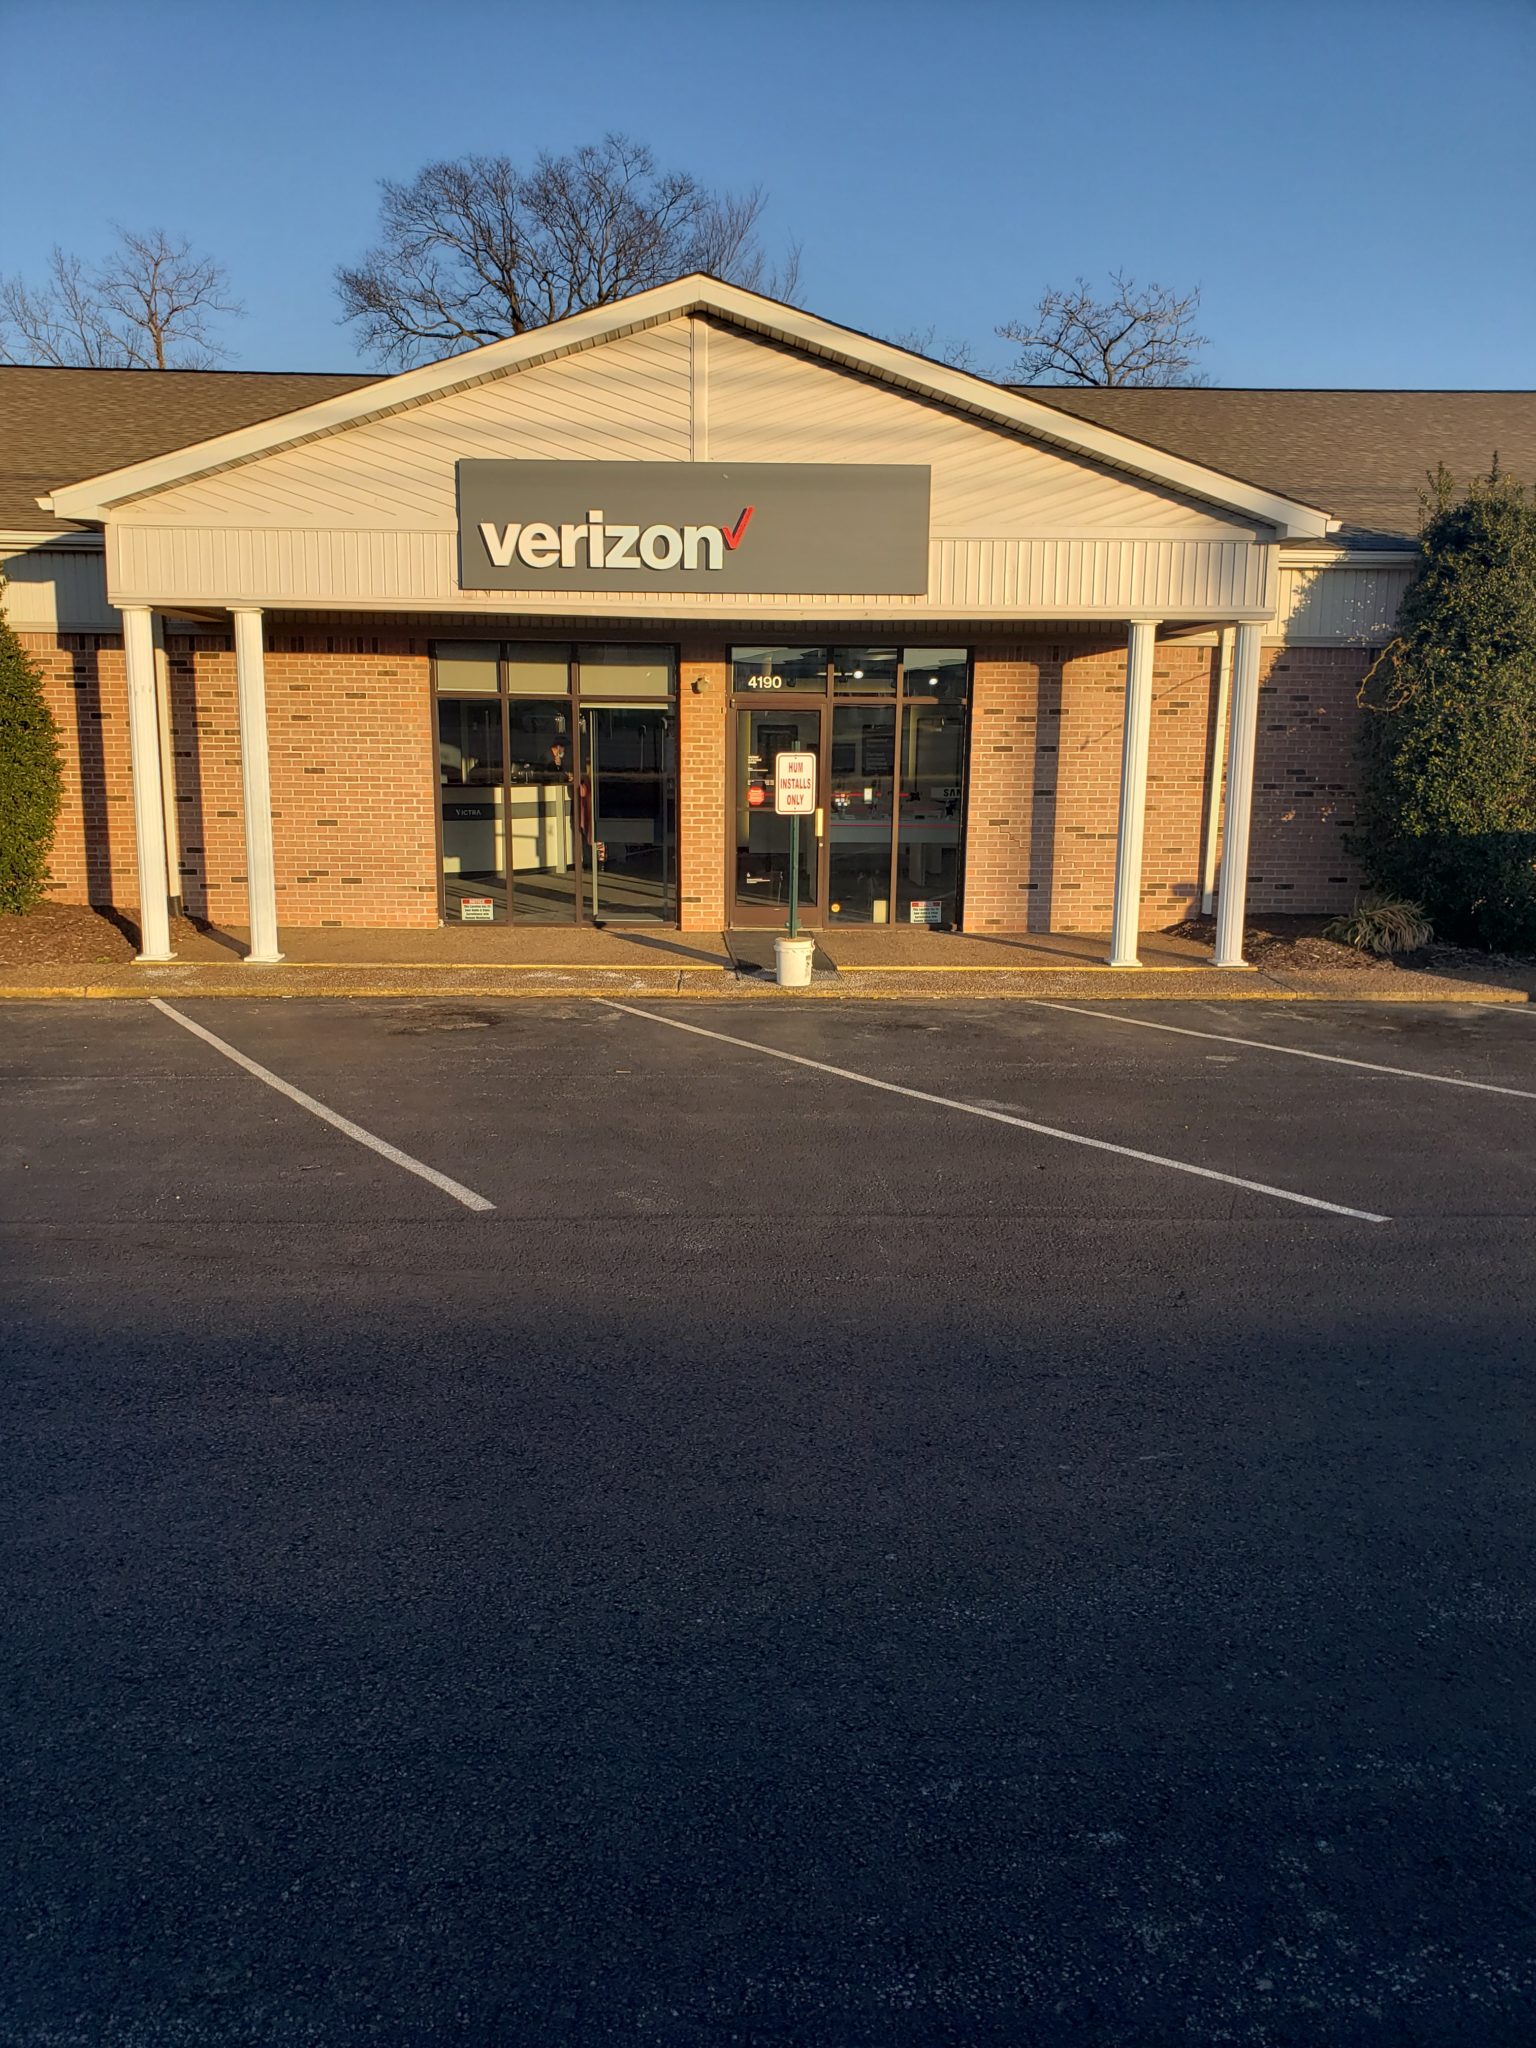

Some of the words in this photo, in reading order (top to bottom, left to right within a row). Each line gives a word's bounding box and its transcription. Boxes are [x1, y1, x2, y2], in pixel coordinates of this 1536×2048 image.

[480, 510, 723, 570] verizon
[748, 675, 782, 689] 4190
[788, 762, 803, 773] HUM
[780, 778, 811, 789] INSTALLS
[786, 794, 805, 806] ONLY
